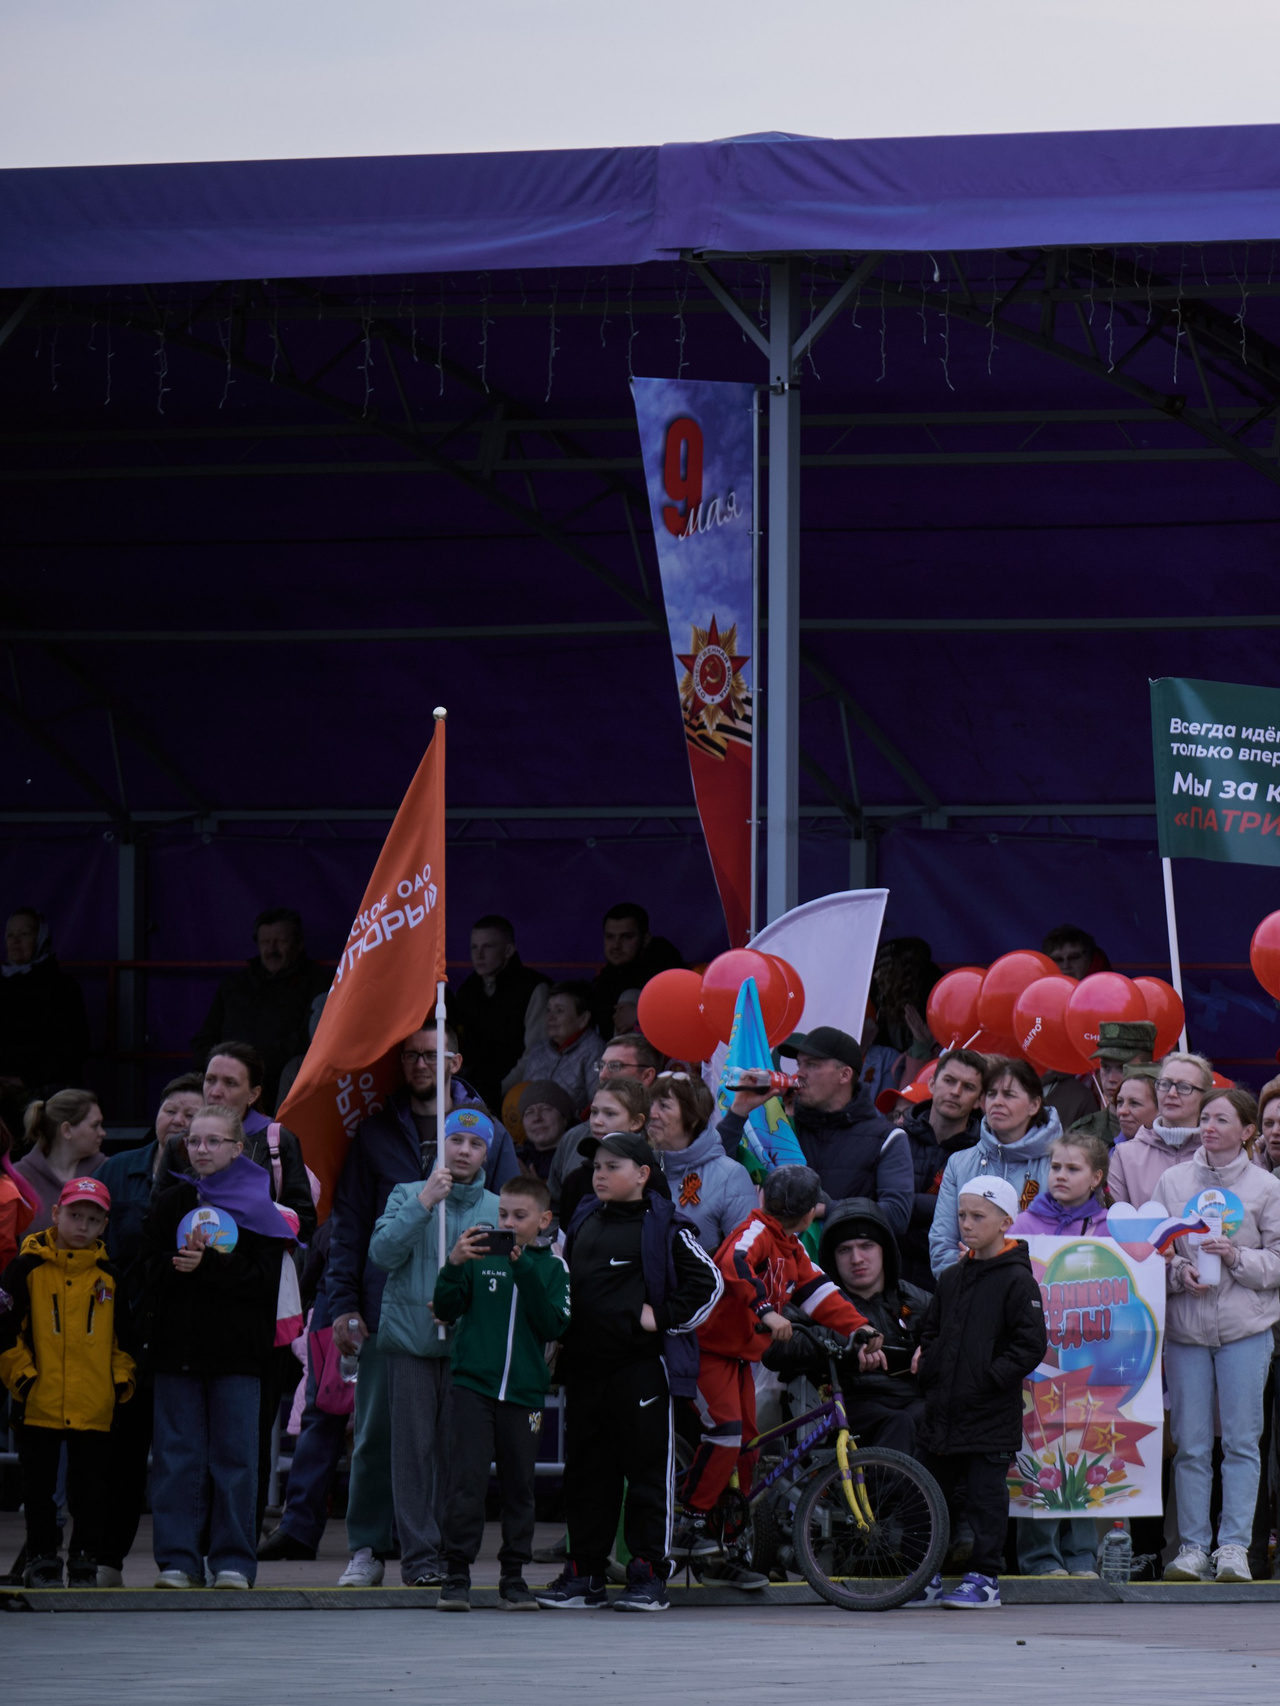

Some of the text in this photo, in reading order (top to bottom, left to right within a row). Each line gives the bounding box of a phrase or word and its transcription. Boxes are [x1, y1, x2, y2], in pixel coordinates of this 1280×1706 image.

[1169, 717, 1236, 741] Всегда
[1170, 742, 1233, 760] только
[1172, 771, 1212, 798] Мы
[1219, 780, 1259, 802] за
[347, 863, 431, 942] СКОЕ ОАО
[481, 1269, 507, 1277] KELME
[488, 1277, 497, 1293] 3
[1045, 1308, 1112, 1350] ЕДЫ!
